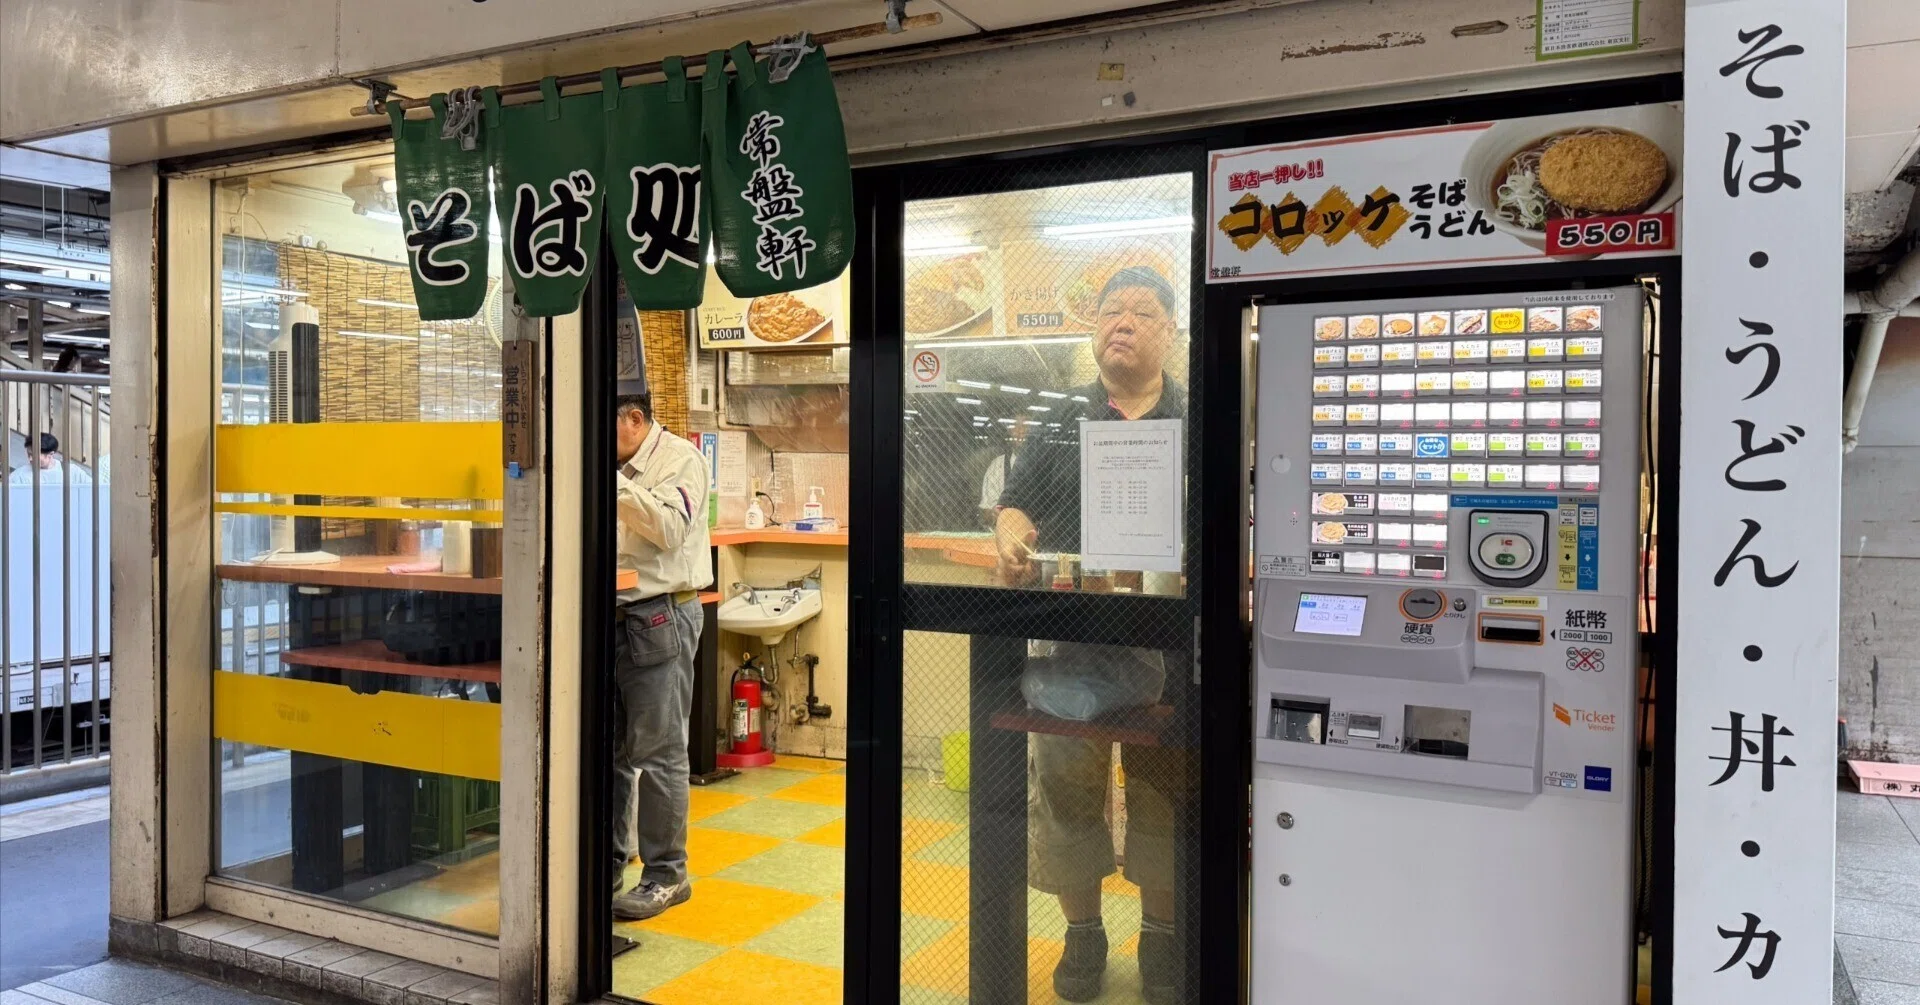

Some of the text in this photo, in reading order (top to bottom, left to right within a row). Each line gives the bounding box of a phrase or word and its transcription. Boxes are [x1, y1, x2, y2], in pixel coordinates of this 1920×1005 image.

[740, 111, 816, 281] 常盤軒
[1408, 179, 1467, 209] そば
[1228, 192, 1400, 239] コロッケ
[1408, 209, 1495, 240] うどん
[1558, 218, 1663, 248] 550円
[1022, 314, 1059, 326] 550円
[712, 328, 741, 339] 600円
[1565, 609, 1607, 629] 紙幣
[1404, 623, 1434, 635] 硬貨
[1573, 709, 1616, 724] Ticket
[1588, 723, 1615, 732] Vender
[1549, 771, 1578, 779] VT-G20V
